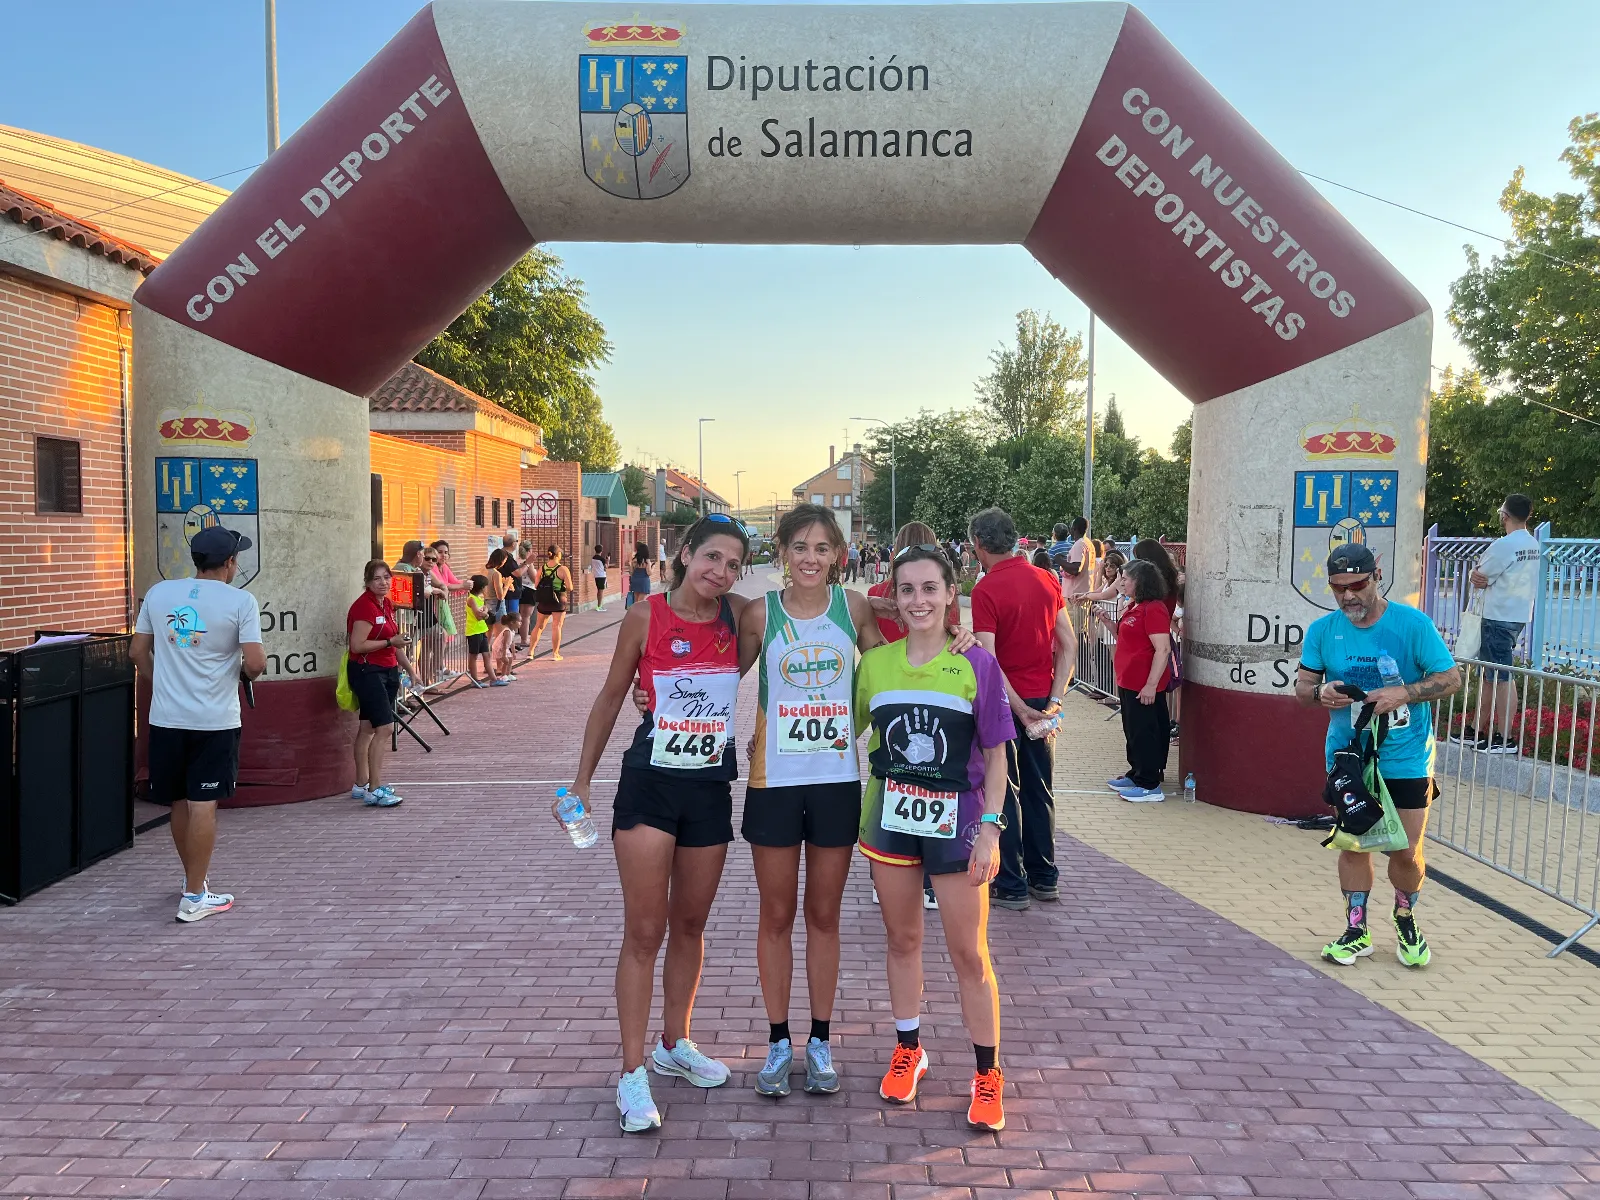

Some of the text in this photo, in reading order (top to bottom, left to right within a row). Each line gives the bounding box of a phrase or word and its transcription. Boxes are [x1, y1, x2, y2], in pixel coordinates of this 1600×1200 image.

[706, 54, 930, 100] Diputación
[707, 117, 974, 158] de Salamanca
[186, 74, 452, 323] CON EL DEPORTE
[1122, 87, 1356, 319] CON NUESTROS
[1095, 134, 1306, 341] DEPORTISTAS
[786, 658, 839, 674] ALCER
[1230, 661, 1257, 685] de
[669, 677, 709, 702] Simón
[778, 702, 849, 718] bedunia
[657, 715, 726, 734] bedunia
[788, 717, 839, 742] 406
[664, 733, 716, 757] 448
[894, 796, 945, 824] 409
